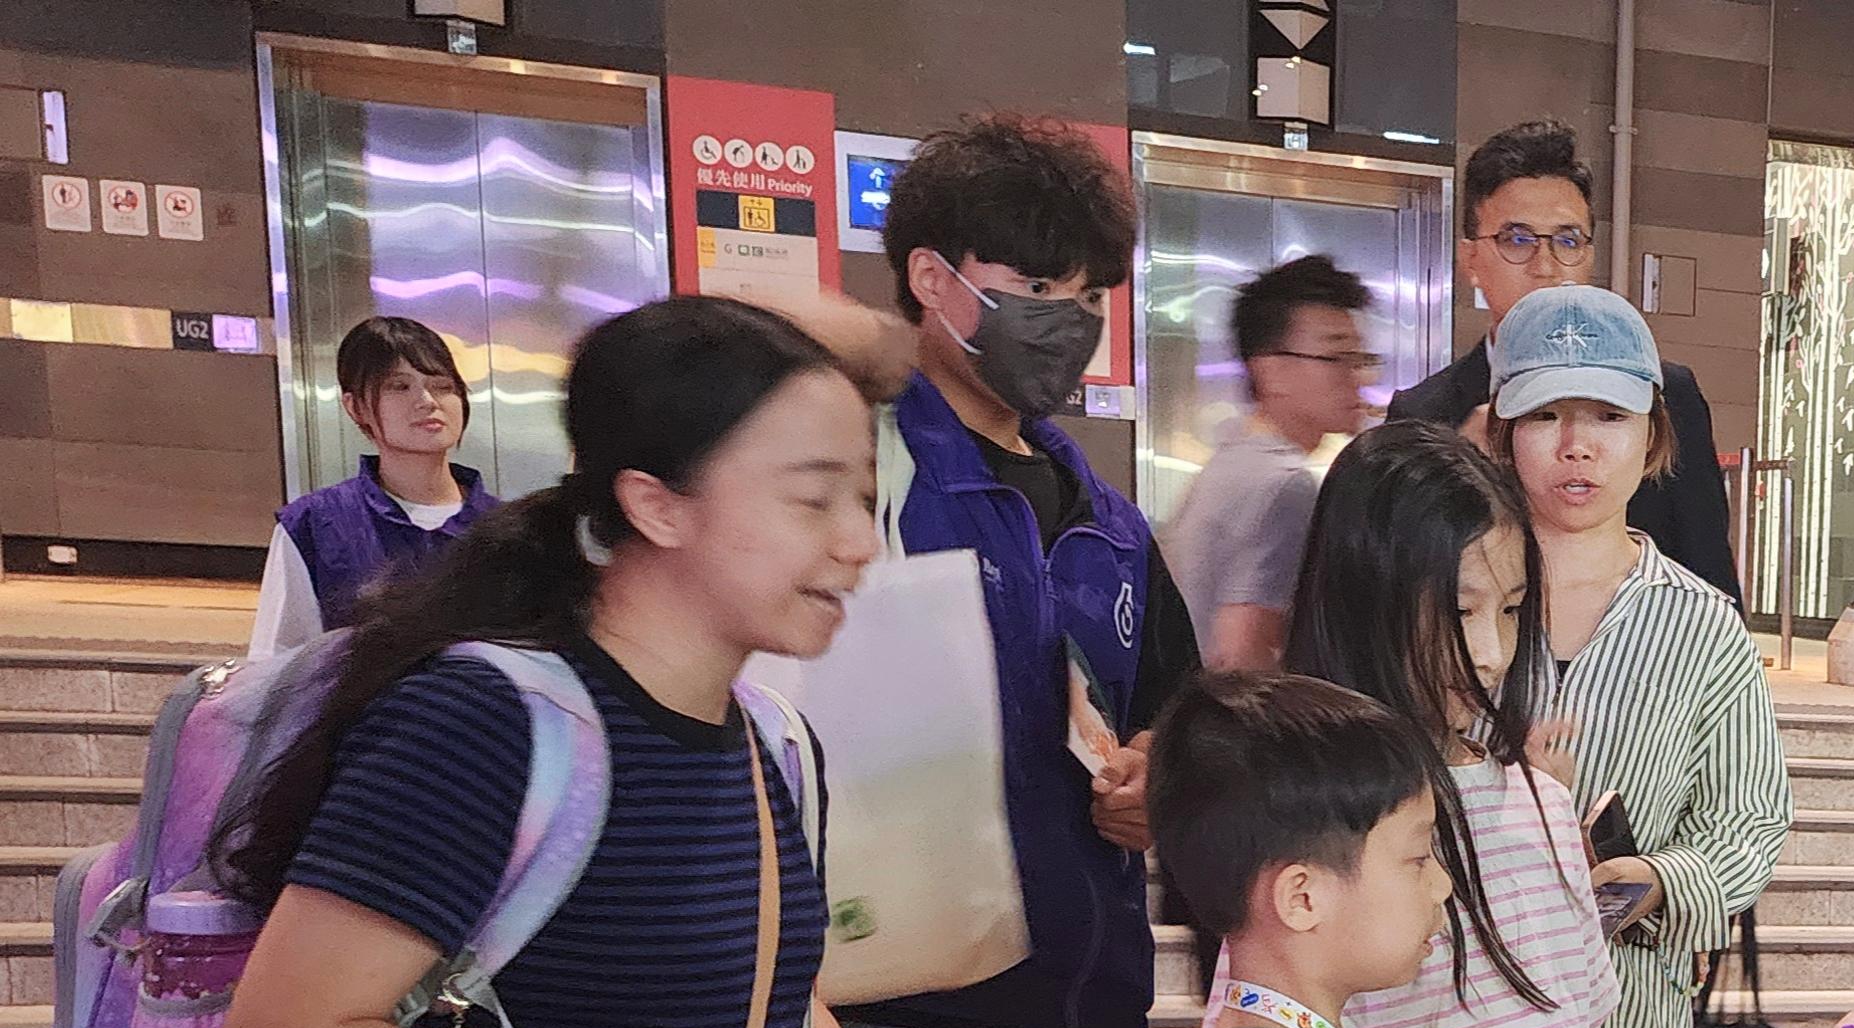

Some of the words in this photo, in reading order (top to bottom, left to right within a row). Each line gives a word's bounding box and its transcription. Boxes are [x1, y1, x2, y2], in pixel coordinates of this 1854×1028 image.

[697, 168, 765, 189] 優先使用
[768, 178, 813, 197] Priority
[176, 319, 209, 339] UG2
